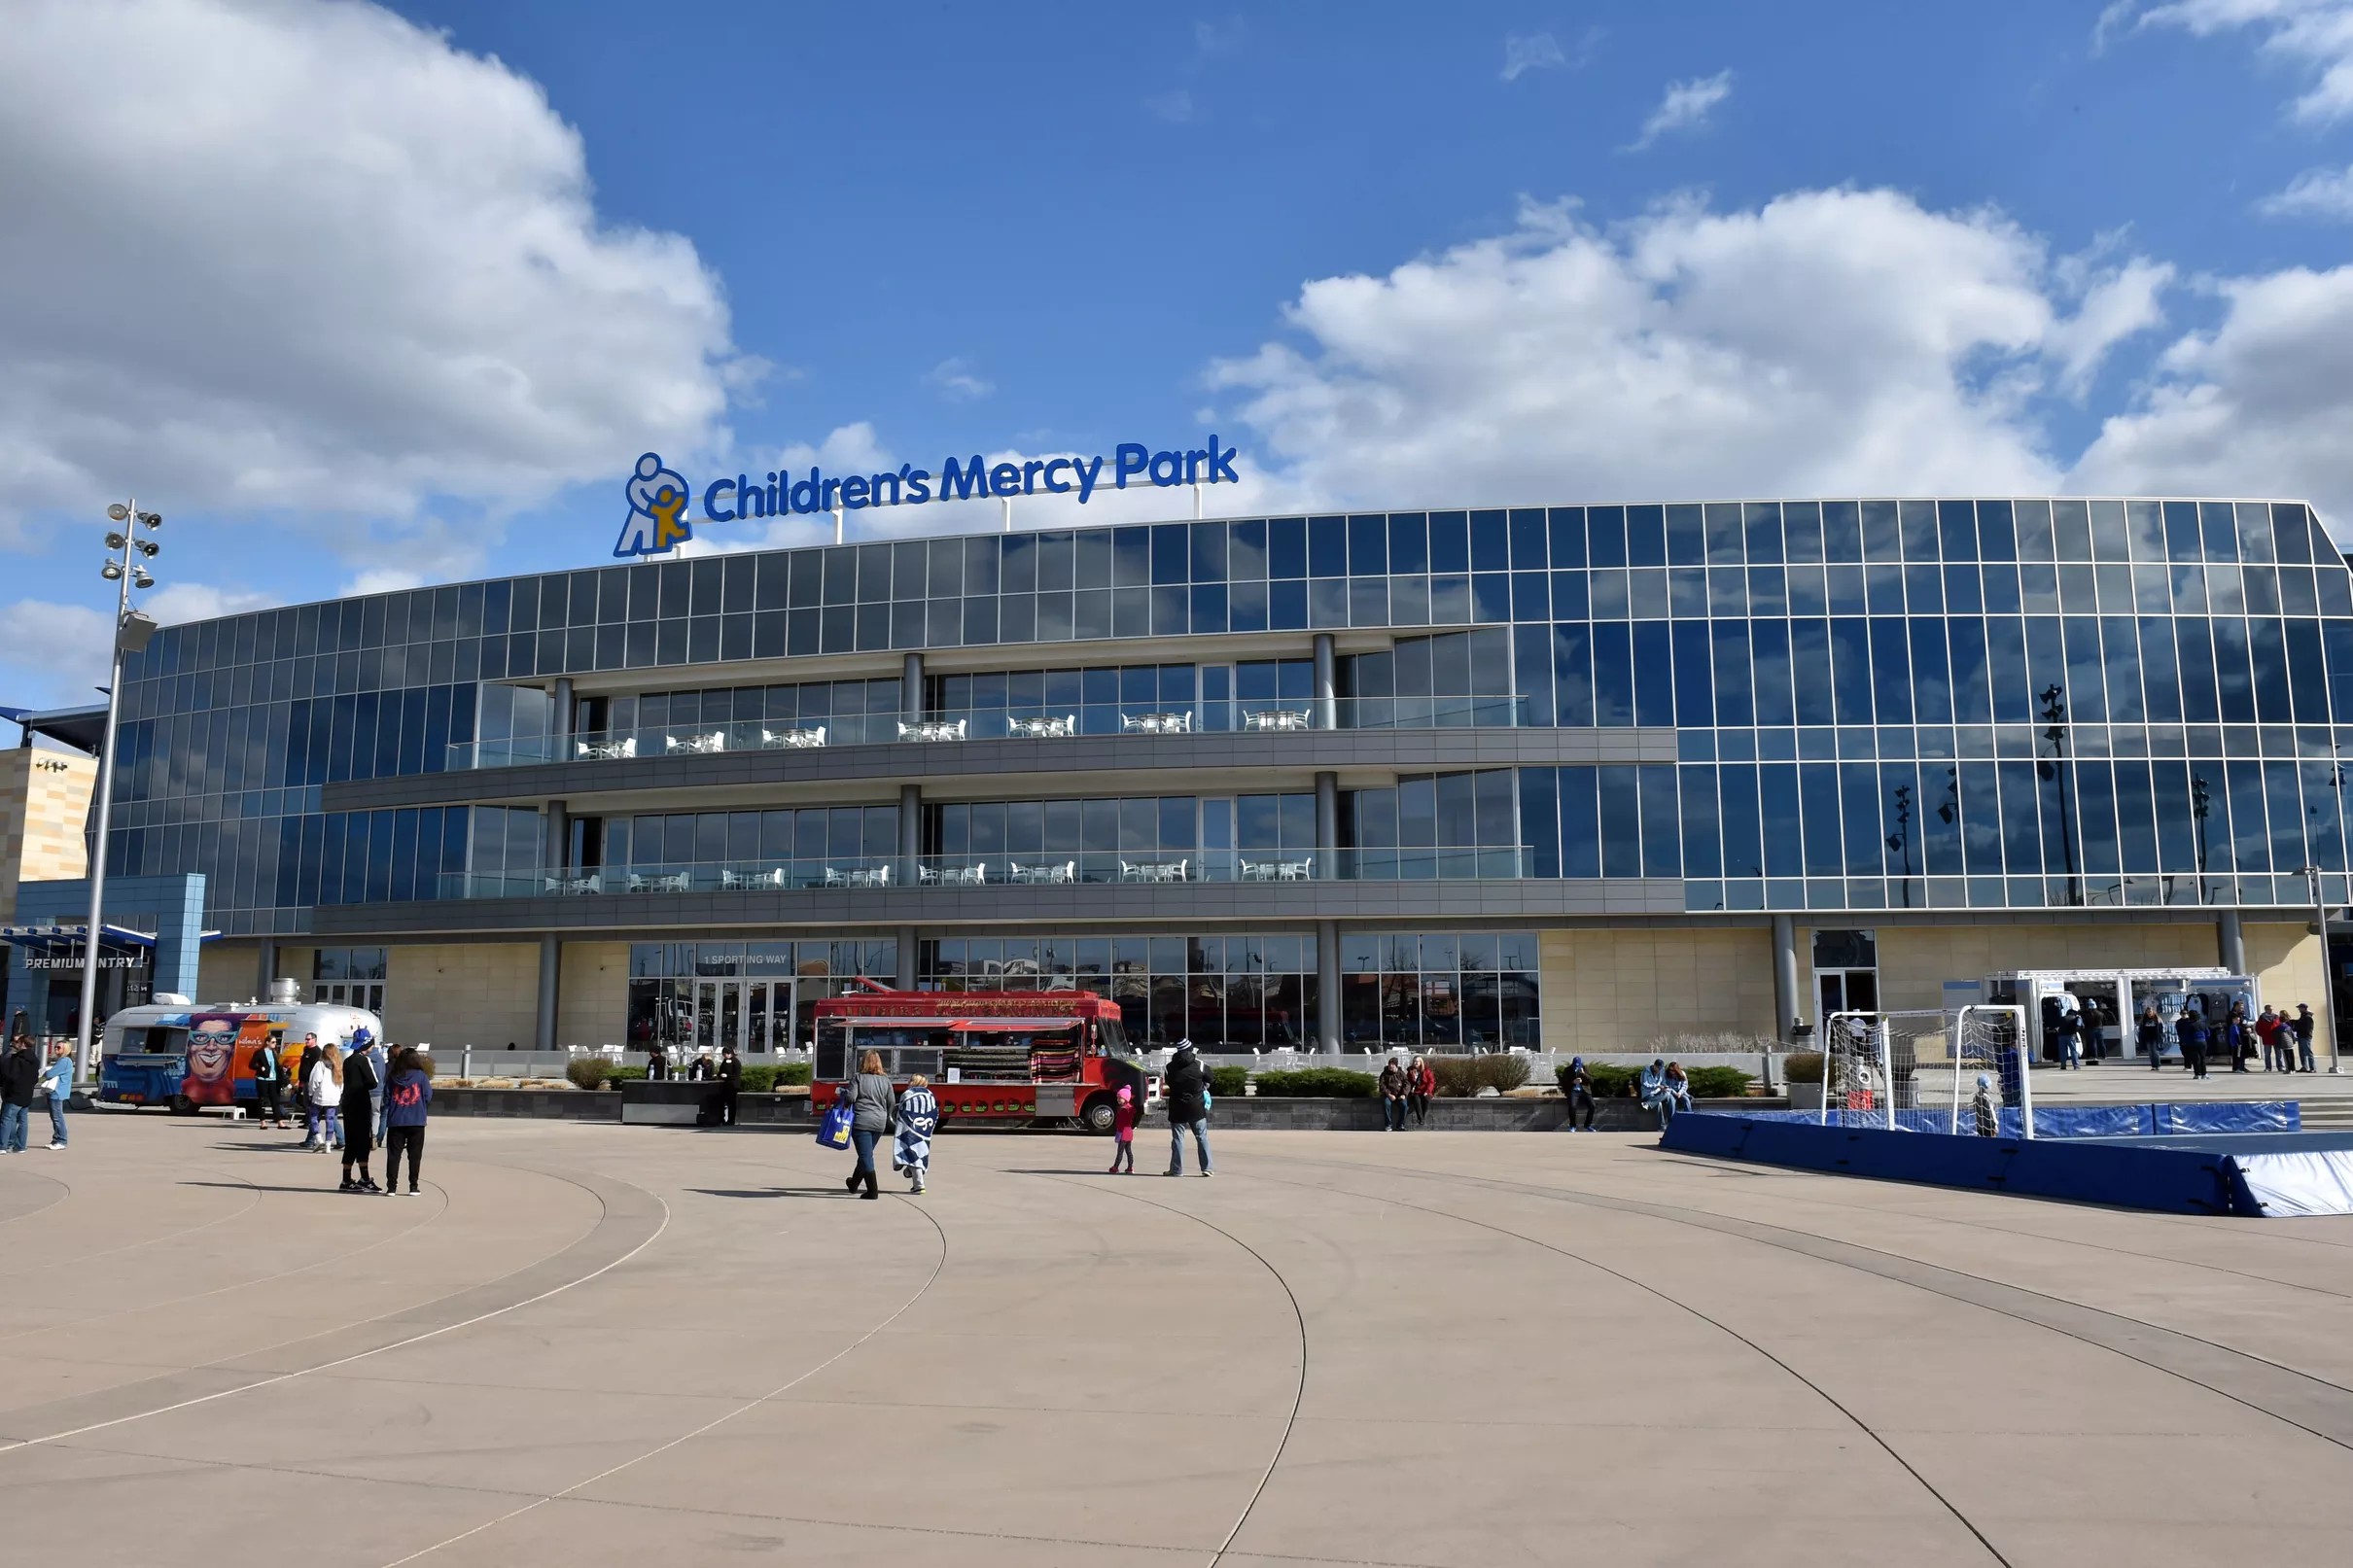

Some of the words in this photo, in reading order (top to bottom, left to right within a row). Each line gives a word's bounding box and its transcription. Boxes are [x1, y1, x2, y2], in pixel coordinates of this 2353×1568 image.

[704, 463, 931, 522] Children's
[939, 454, 1104, 505] Mercy
[1115, 434, 1239, 490] Park
[25, 958, 85, 969] PREMIUM
[98, 957, 135, 968] NTRY
[704, 956, 709, 964] 1
[712, 955, 763, 964] SPORTING
[766, 955, 787, 964] WAY
